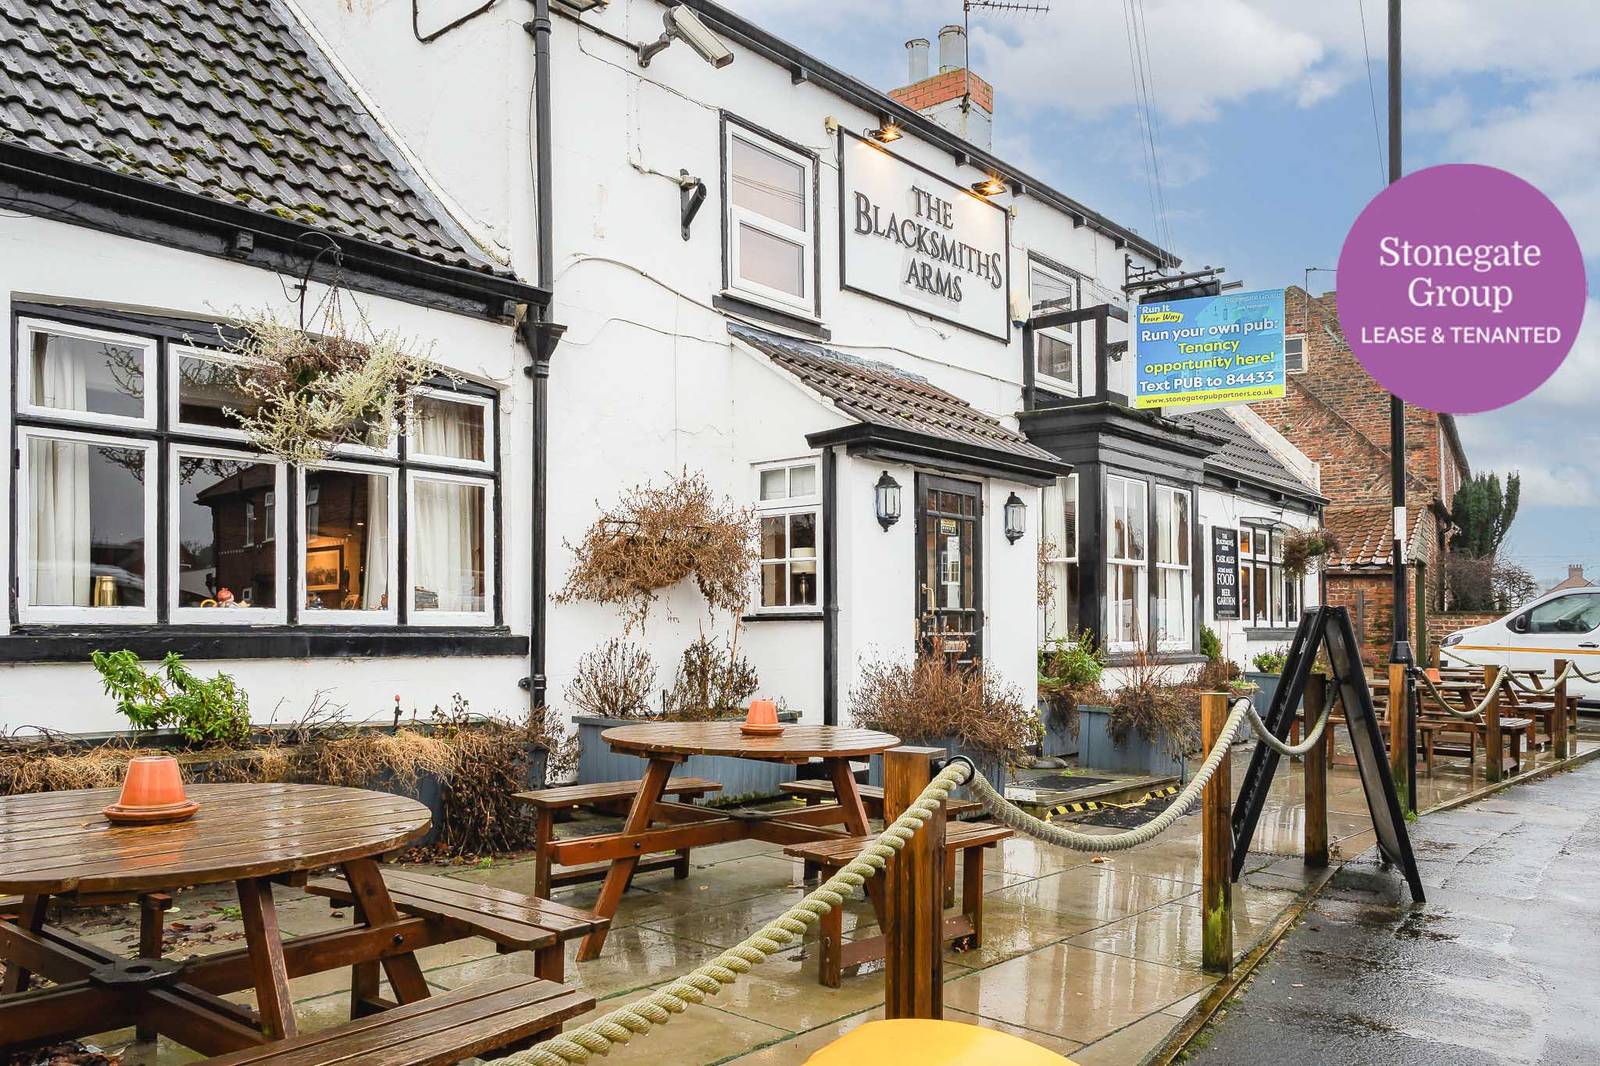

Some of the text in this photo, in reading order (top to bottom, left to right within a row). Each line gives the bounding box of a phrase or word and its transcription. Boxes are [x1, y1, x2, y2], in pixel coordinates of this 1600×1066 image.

[912, 185, 953, 230] THE
[854, 191, 1002, 289] BLACKSMITHS
[906, 258, 963, 302] ARMS
[1142, 305, 1160, 314] Run
[1163, 313, 1181, 323] Way
[1141, 317, 1279, 341] Run your own pub:
[1178, 340, 1240, 354] Tenancy
[1144, 352, 1275, 375] opportunity here!
[1140, 371, 1274, 392] Text PUB to 84433
[1146, 389, 1273, 404] www.stonegatepubpartners.co.uk
[1216, 573, 1234, 586] FOOD
[1222, 588, 1230, 596] BEER
[1216, 596, 1236, 606] GARDEN
